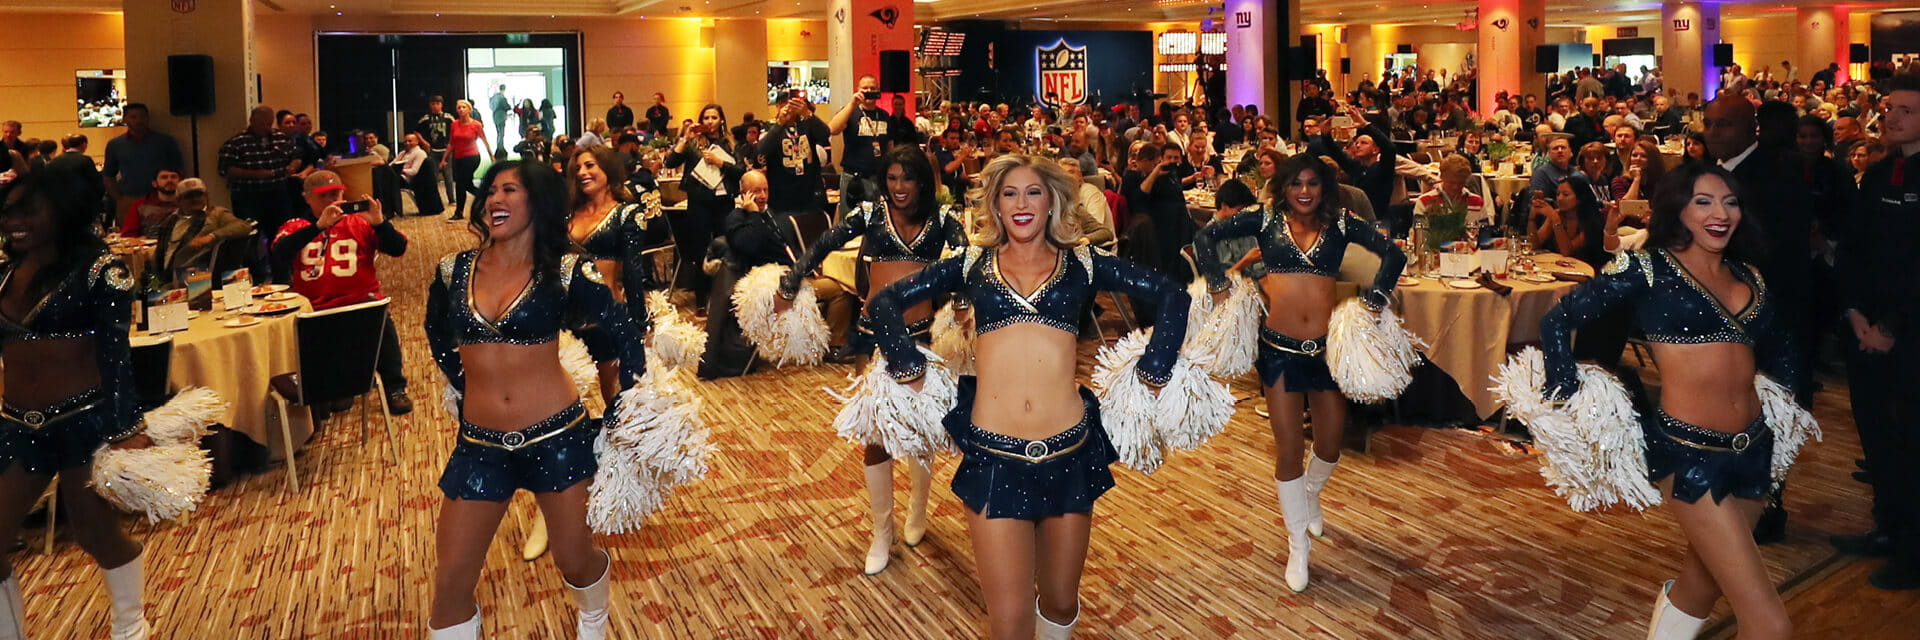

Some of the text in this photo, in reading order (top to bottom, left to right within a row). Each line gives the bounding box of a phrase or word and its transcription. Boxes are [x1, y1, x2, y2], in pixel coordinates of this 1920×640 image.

[1236, 11, 1251, 28] ny
[1673, 19, 1690, 31] ny
[1044, 72, 1082, 103] NFL
[300, 239, 358, 282] 99
